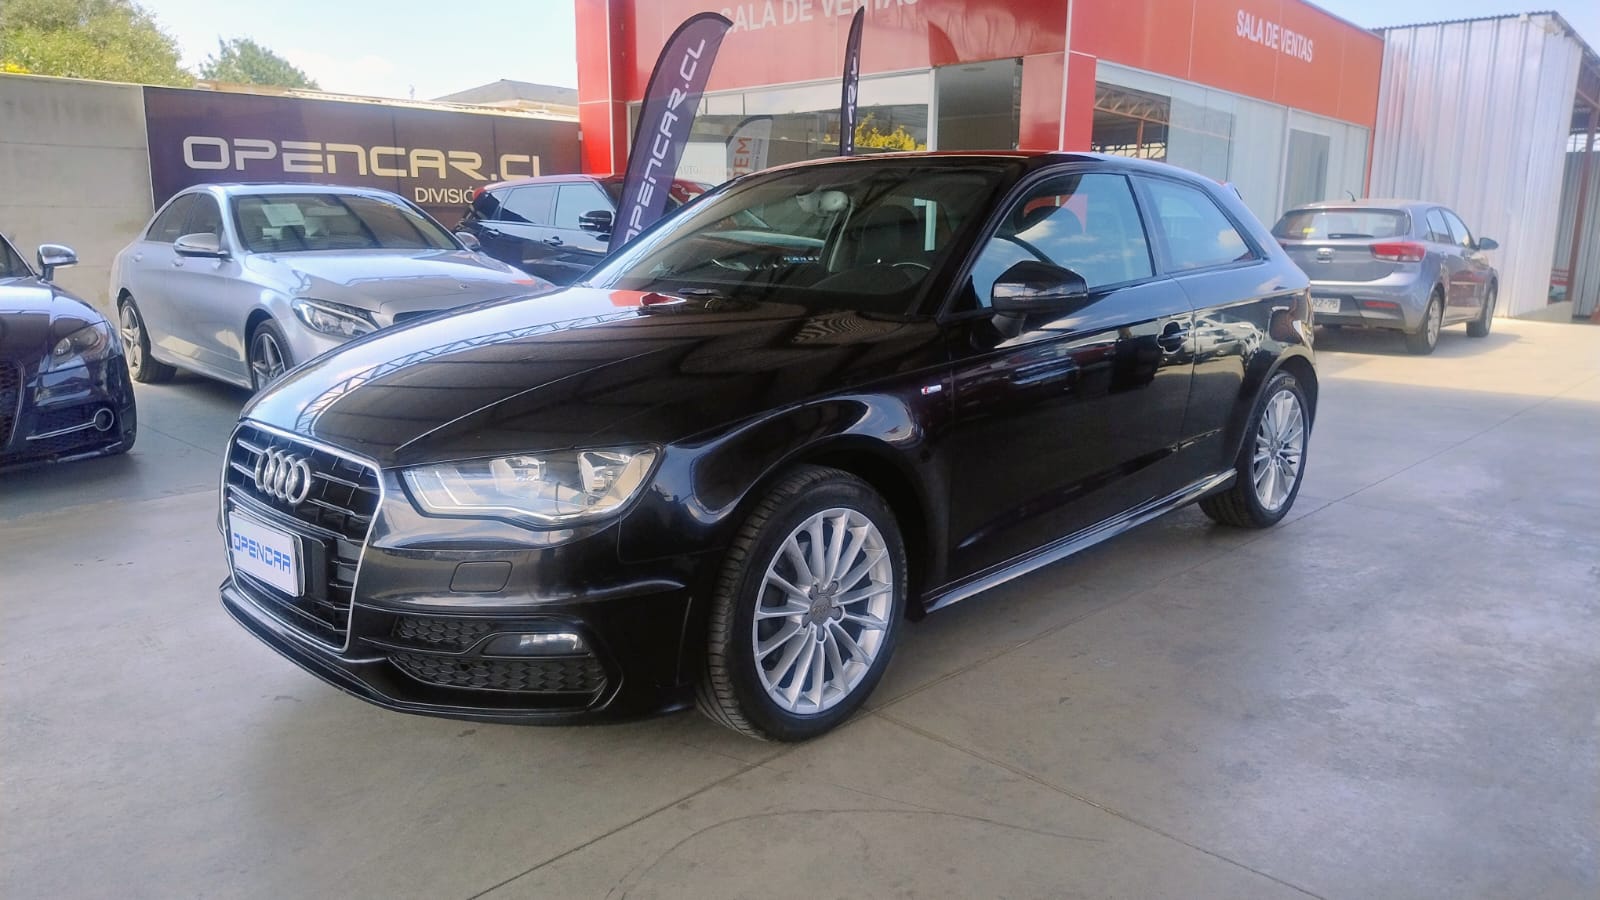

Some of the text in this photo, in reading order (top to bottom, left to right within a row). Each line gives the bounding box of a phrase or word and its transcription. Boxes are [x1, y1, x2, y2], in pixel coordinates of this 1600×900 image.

[783, 0, 813, 25] DE
[1236, 9, 1313, 63] SALA DE VENTAS
[233, 532, 291, 574] OPENCAR
